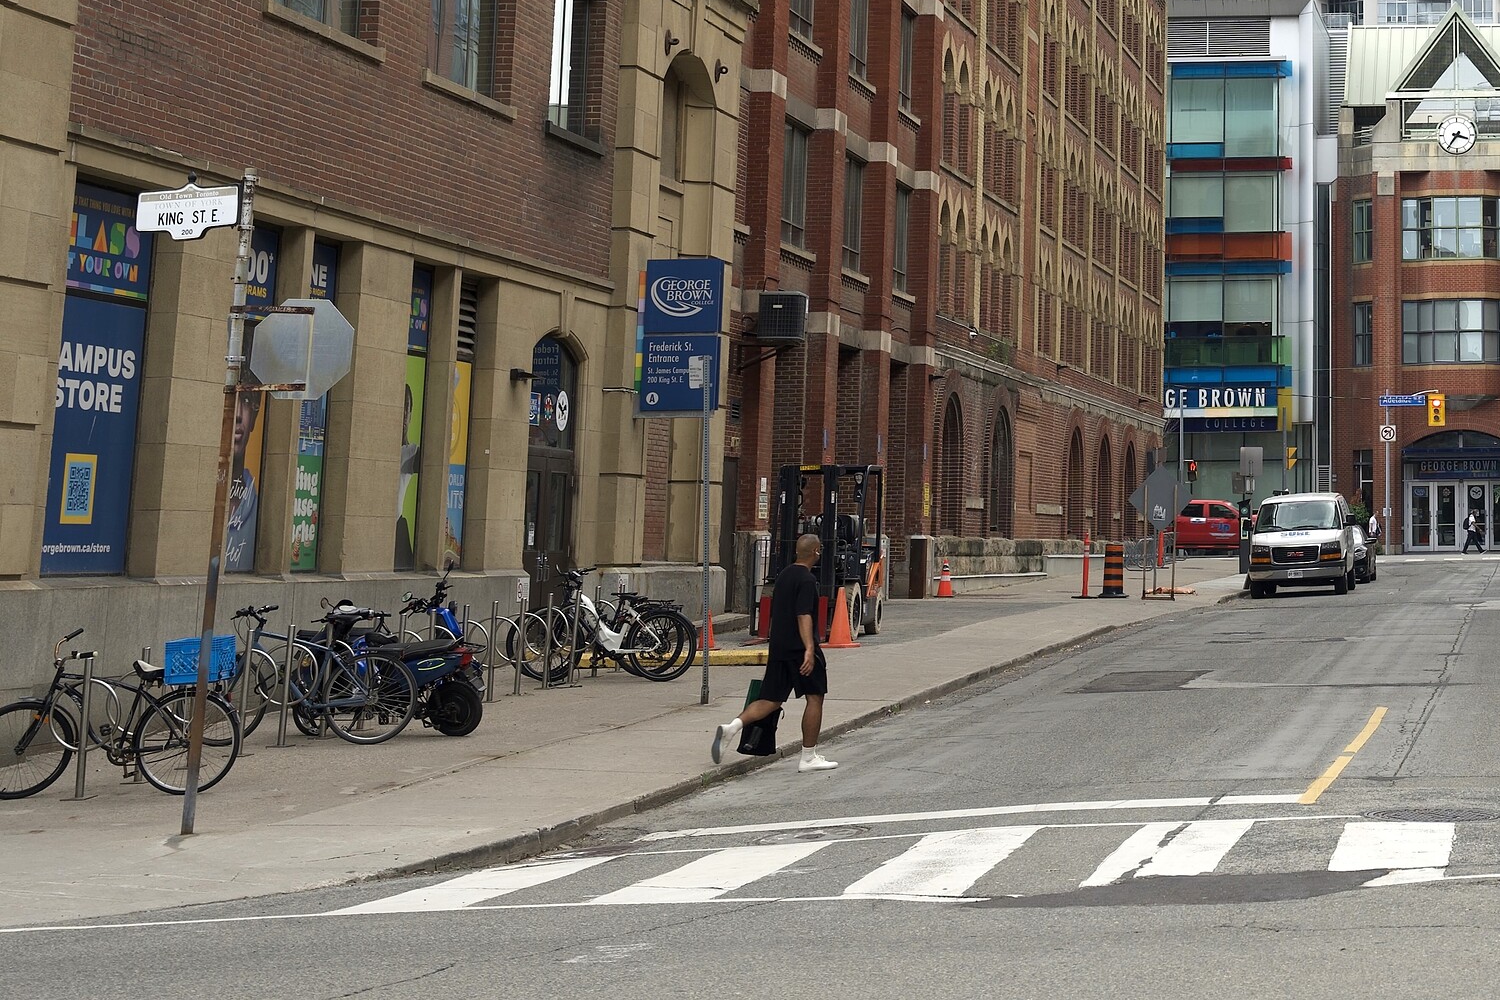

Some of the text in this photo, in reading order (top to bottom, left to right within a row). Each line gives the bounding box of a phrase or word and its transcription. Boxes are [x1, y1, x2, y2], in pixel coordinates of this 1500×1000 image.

[154, 198, 223, 210] TOWN OF YORK
[158, 209, 220, 226] KING ST. E.
[80, 253, 111, 278] YOUR
[115, 261, 139, 282] OWN
[310, 264, 328, 288] NE
[660, 279, 711, 291] GEORGE
[246, 286, 267, 298] RAMS
[666, 289, 712, 301] BROWN
[649, 342, 694, 352] Frederick St.
[58, 341, 136, 379] AMPUS
[648, 353, 680, 363] Entrance
[672, 367, 689, 375] Campu
[658, 376, 670, 385] King
[649, 394, 656, 403] A
[1165, 388, 1266, 408] GE BROWN
[1205, 418, 1265, 428] COLLEGE
[1420, 460, 1497, 471] GEORGE BROWN
[449, 473, 464, 486] ORLD
[230, 475, 255, 507] ctical
[447, 490, 464, 510] ITS
[293, 498, 318, 517] use-
[228, 506, 243, 532] kes
[43, 543, 110, 555] orgebrown.ca/store
[224, 537, 246, 569] fect
